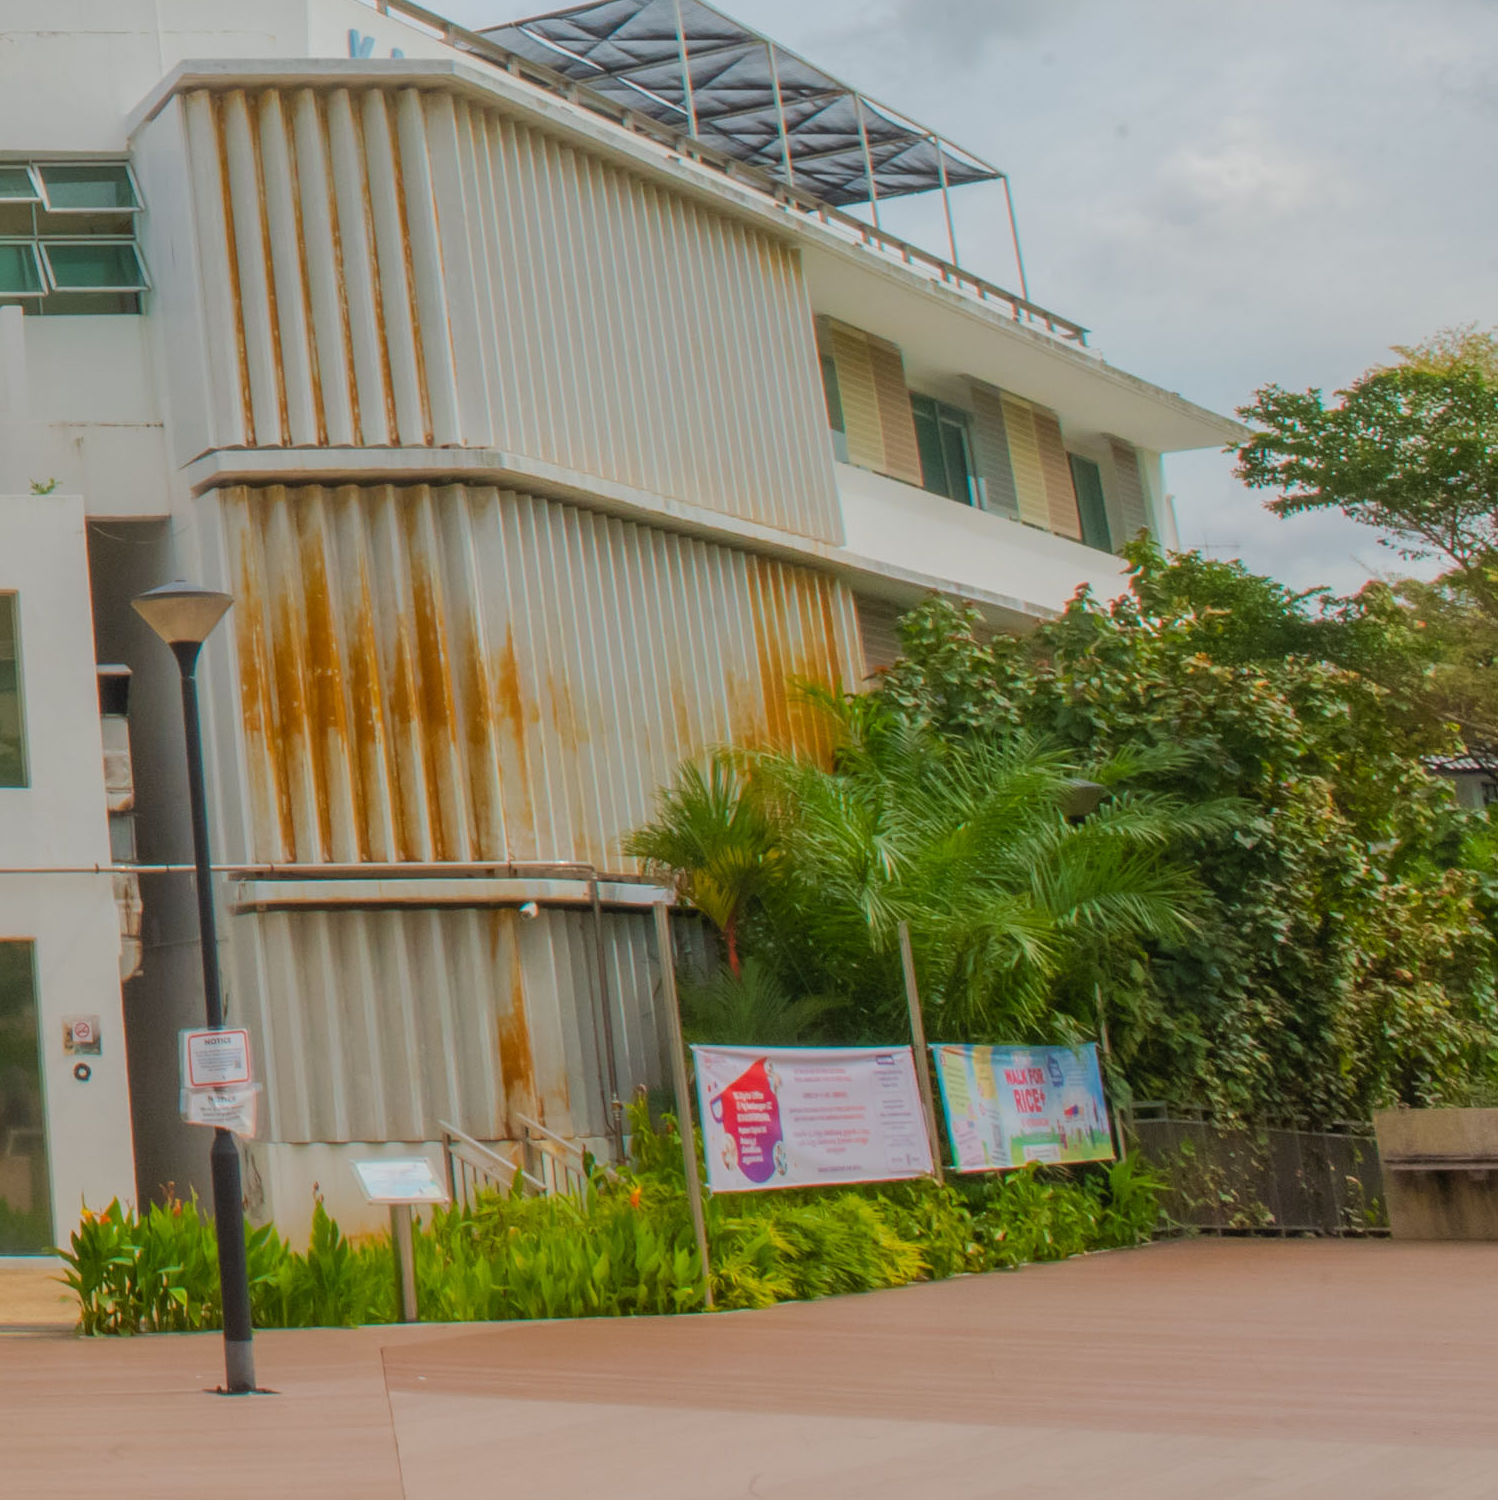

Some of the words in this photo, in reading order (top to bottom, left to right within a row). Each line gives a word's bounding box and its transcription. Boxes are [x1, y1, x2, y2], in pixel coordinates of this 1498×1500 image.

[204, 1036, 231, 1046] NOTICE
[1004, 1068, 1028, 1085] WALK
[1027, 1067, 1046, 1085] FOR
